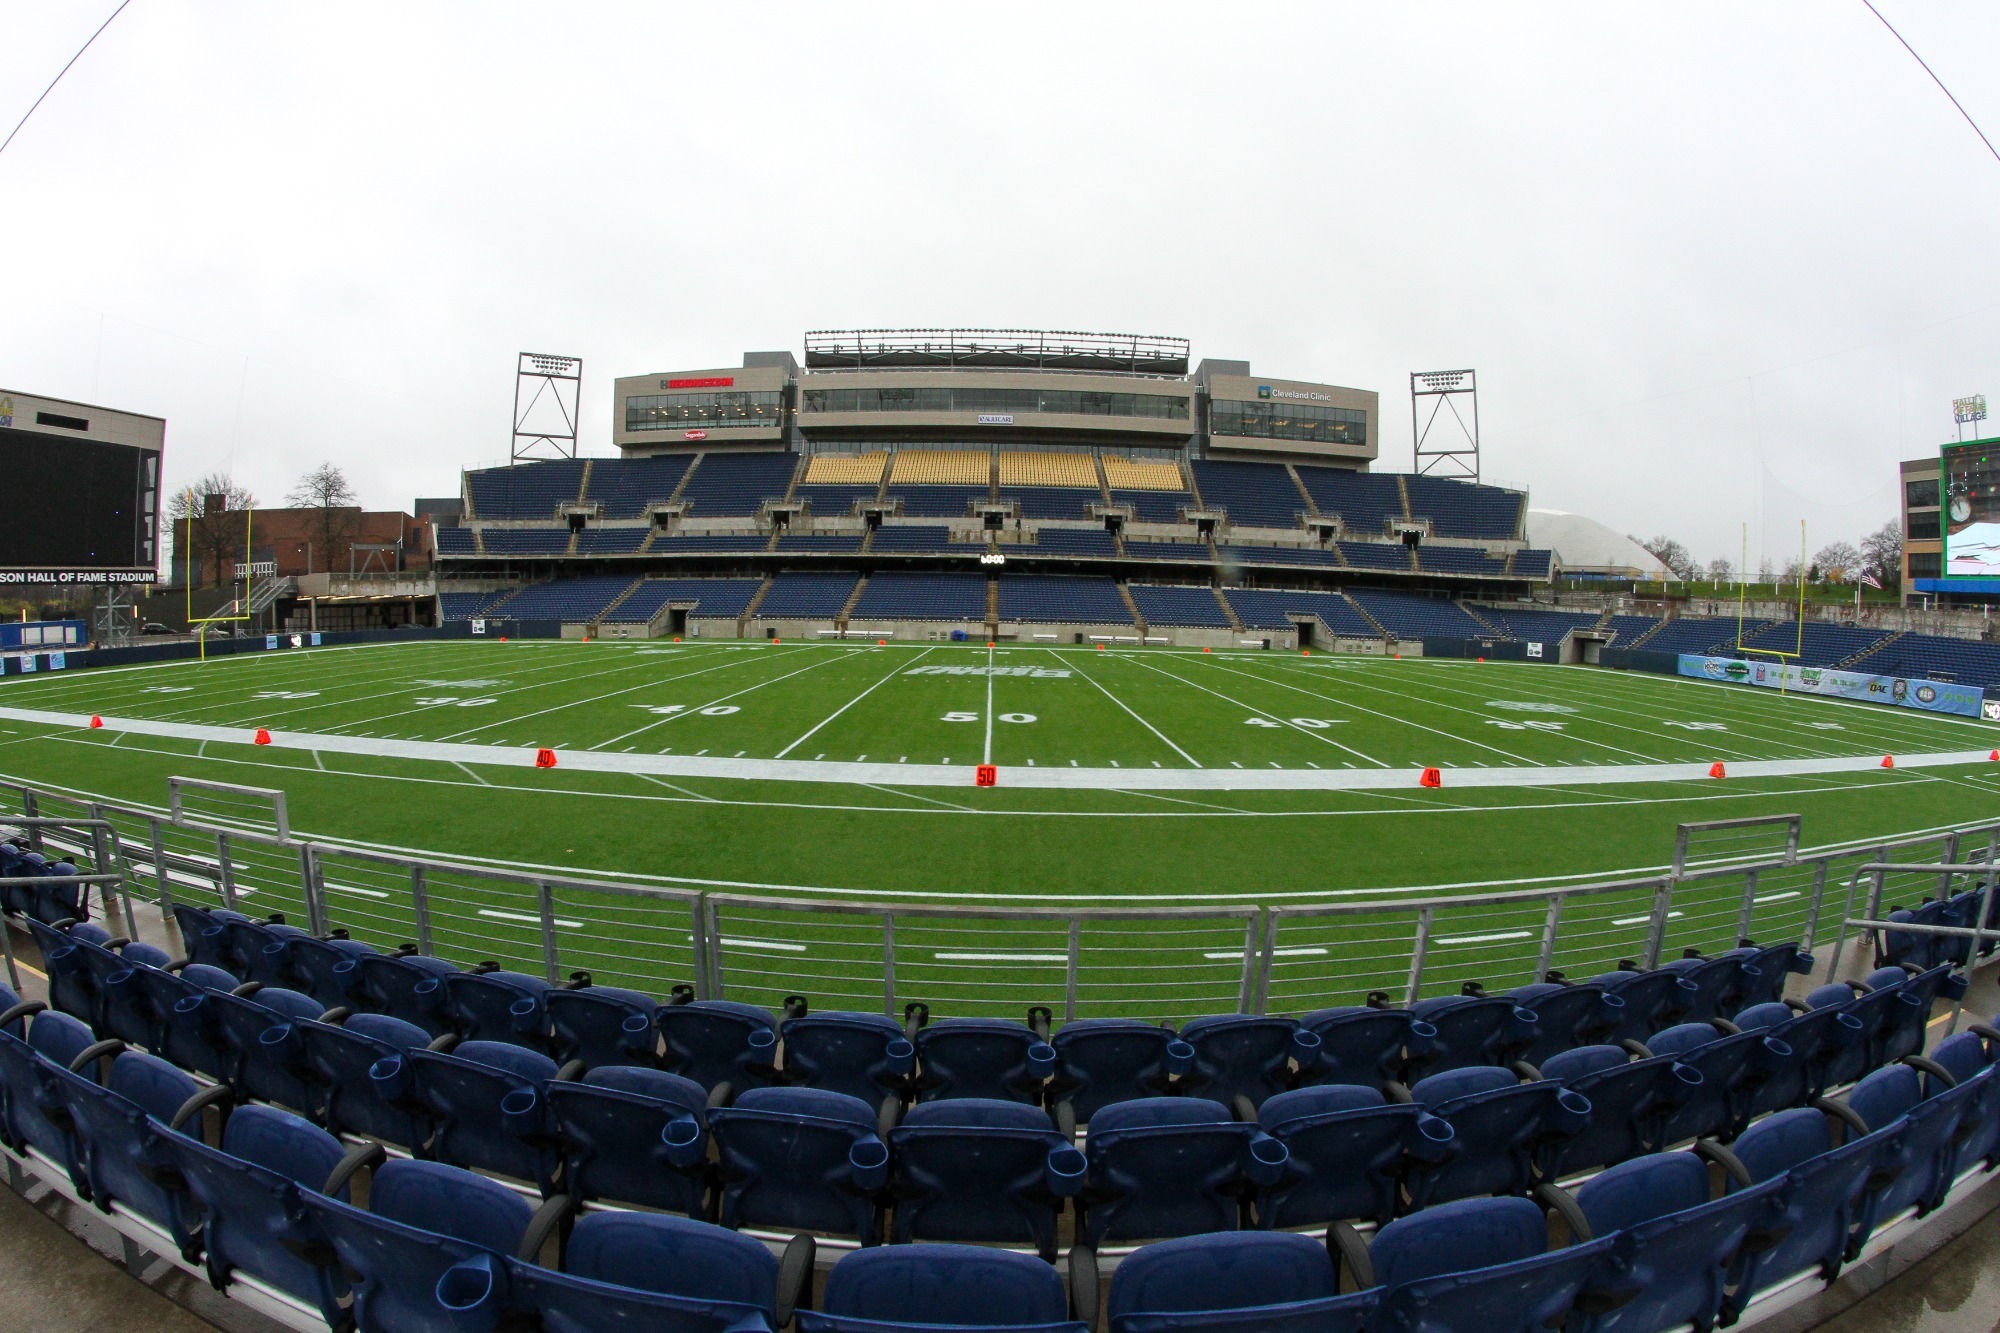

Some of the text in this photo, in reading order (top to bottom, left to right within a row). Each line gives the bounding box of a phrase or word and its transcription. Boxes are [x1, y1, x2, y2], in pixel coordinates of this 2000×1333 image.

[1272, 389, 1331, 401] Cleveland Clinic
[1954, 411, 1987, 423] VILLAGE
[27, 572, 57, 582] HALL
[59, 572, 75, 582] OF
[77, 572, 107, 582] FAME
[108, 572, 154, 582] STADIUM
[940, 711, 1038, 723] 50
[537, 750, 550, 765] 40
[978, 767, 995, 784] 50
[1428, 769, 1440, 785] 40
